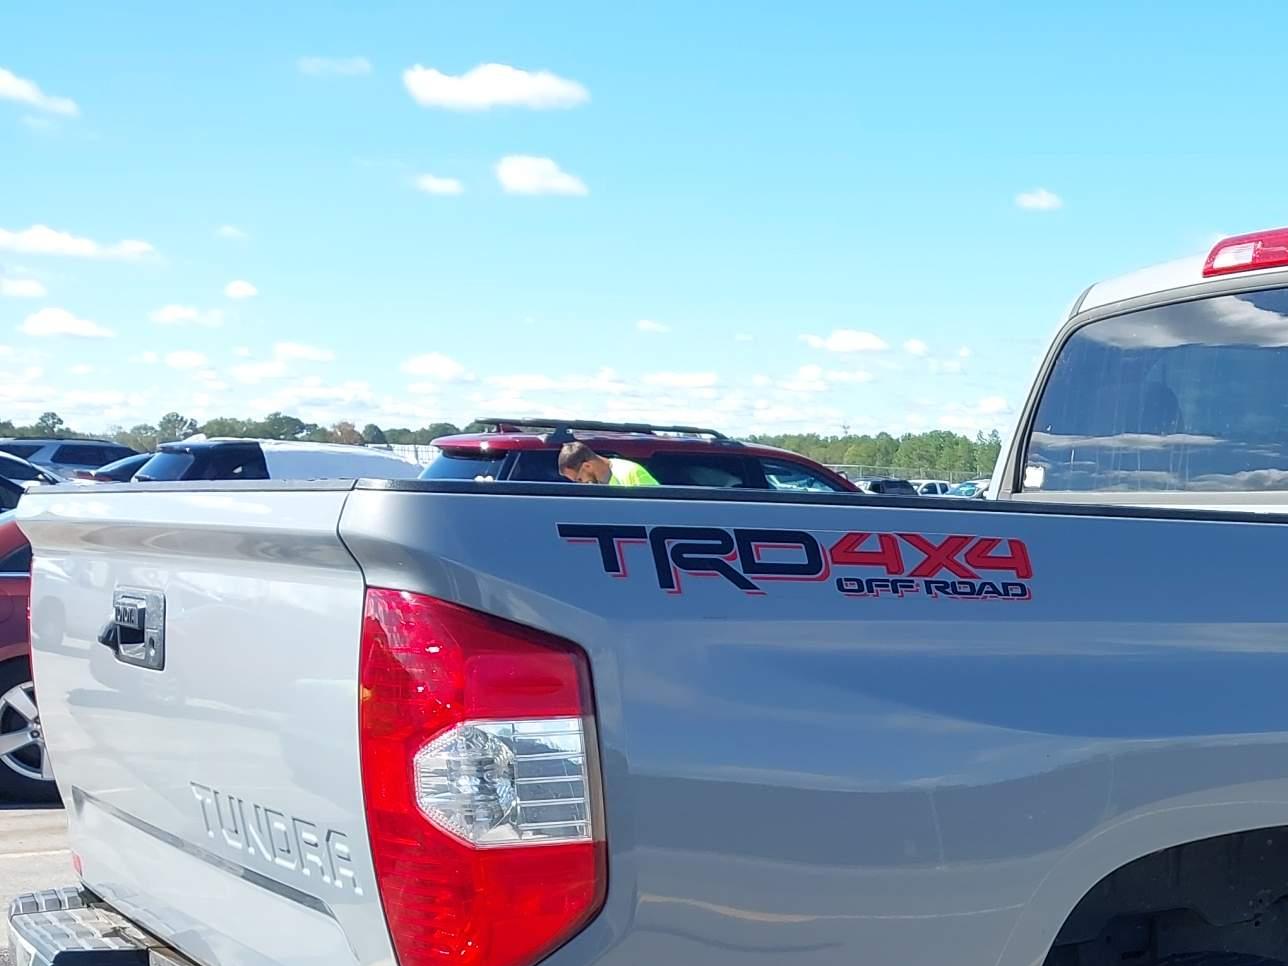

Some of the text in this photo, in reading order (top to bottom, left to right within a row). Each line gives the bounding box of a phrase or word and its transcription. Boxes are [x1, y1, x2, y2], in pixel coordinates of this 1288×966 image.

[557, 522, 830, 595] TRD
[836, 577, 1033, 600] OFF ROAD
[190, 781, 363, 895] TUNDRA
